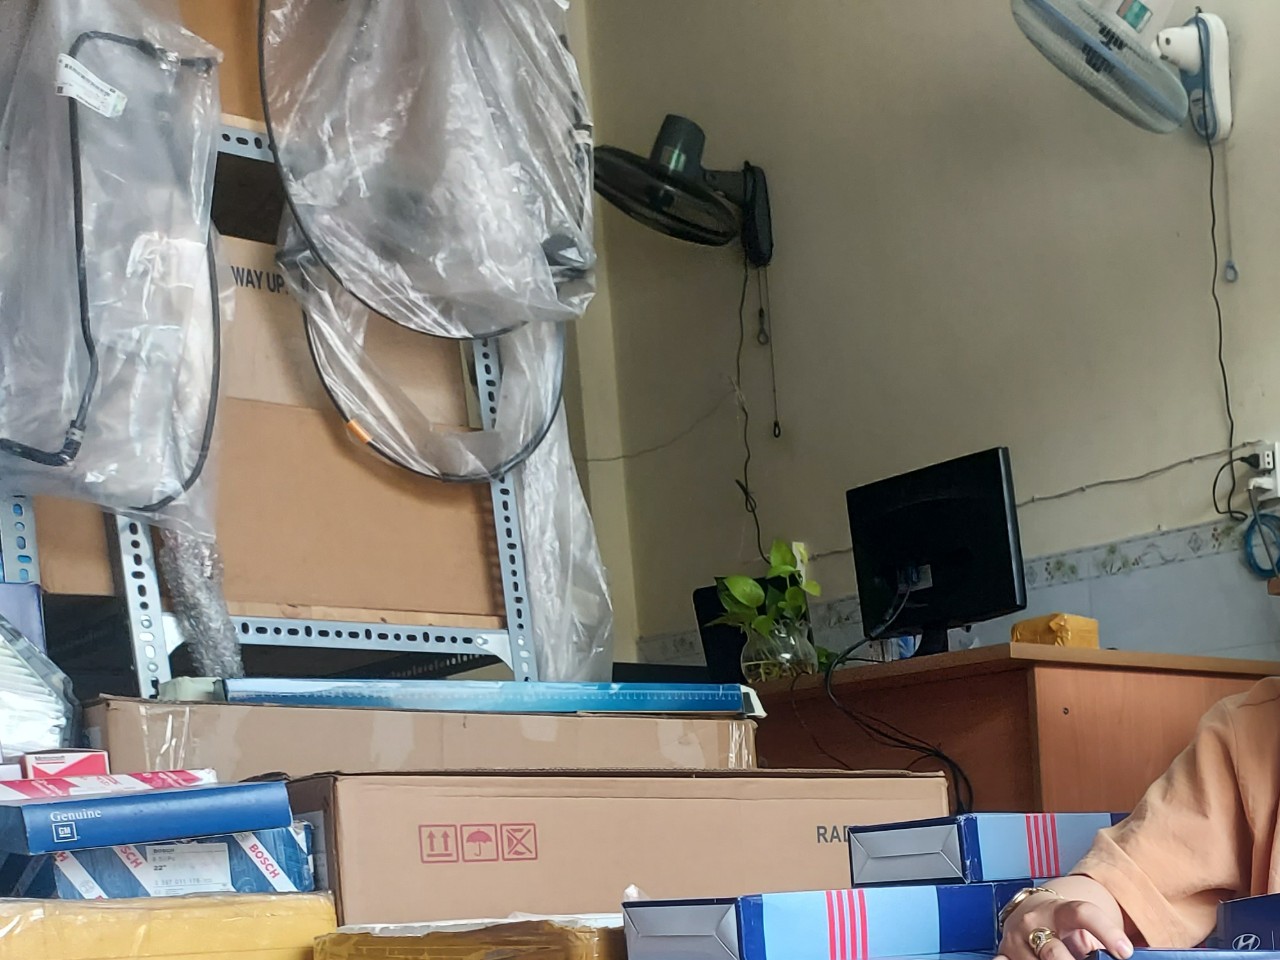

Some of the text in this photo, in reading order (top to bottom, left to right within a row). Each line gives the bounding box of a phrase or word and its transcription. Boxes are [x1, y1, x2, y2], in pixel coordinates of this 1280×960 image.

[231, 265, 263, 290] WAY
[50, 808, 102, 823] Genuine
[58, 826, 72, 838] GM
[120, 844, 143, 869] SCH
[249, 843, 280, 879] BOSCH
